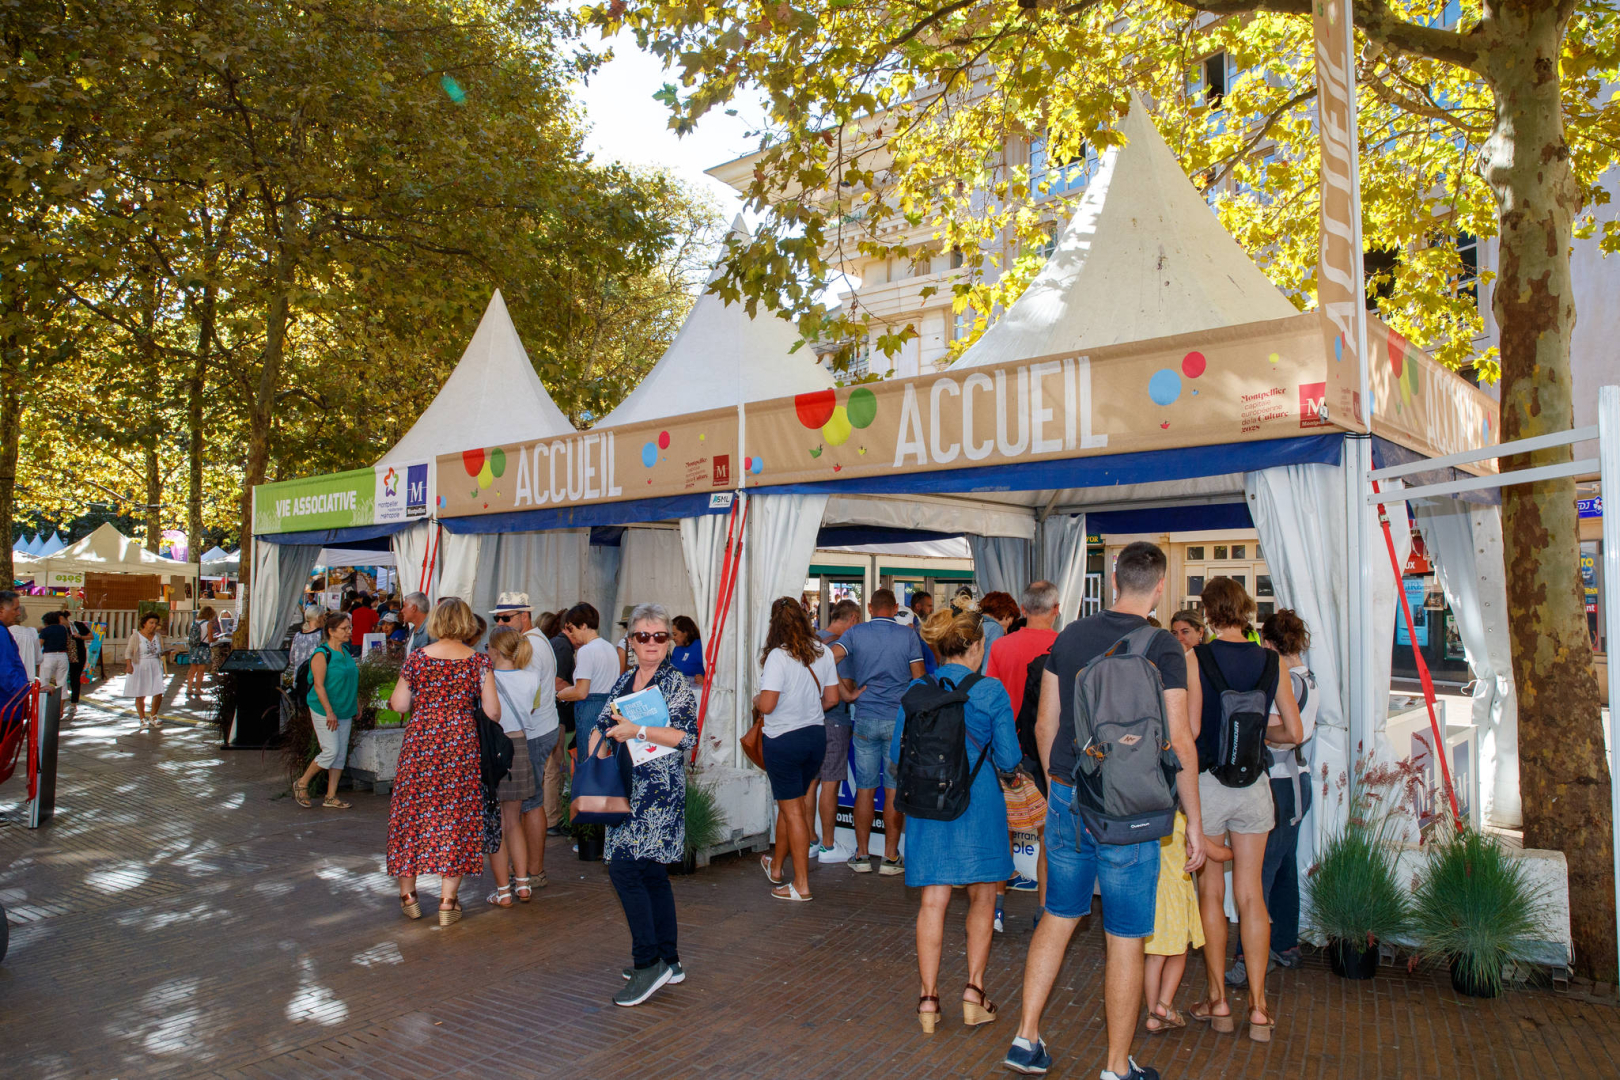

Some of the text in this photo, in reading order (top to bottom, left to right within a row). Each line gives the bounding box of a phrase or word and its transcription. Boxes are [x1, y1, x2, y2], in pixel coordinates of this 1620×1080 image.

[1317, 39, 1357, 356] ACCUEIL
[1241, 387, 1286, 403] Montpellier
[1244, 399, 1271, 410] capitale
[893, 356, 1108, 467] ACCUEIL
[1305, 396, 1325, 416] M
[1258, 411, 1288, 422] Culture
[514, 431, 622, 507] ACCUEIL
[716, 465, 727, 478] M
[410, 481, 423, 502] M
[276, 490, 357, 517] VIE ASSOCIATIVE
